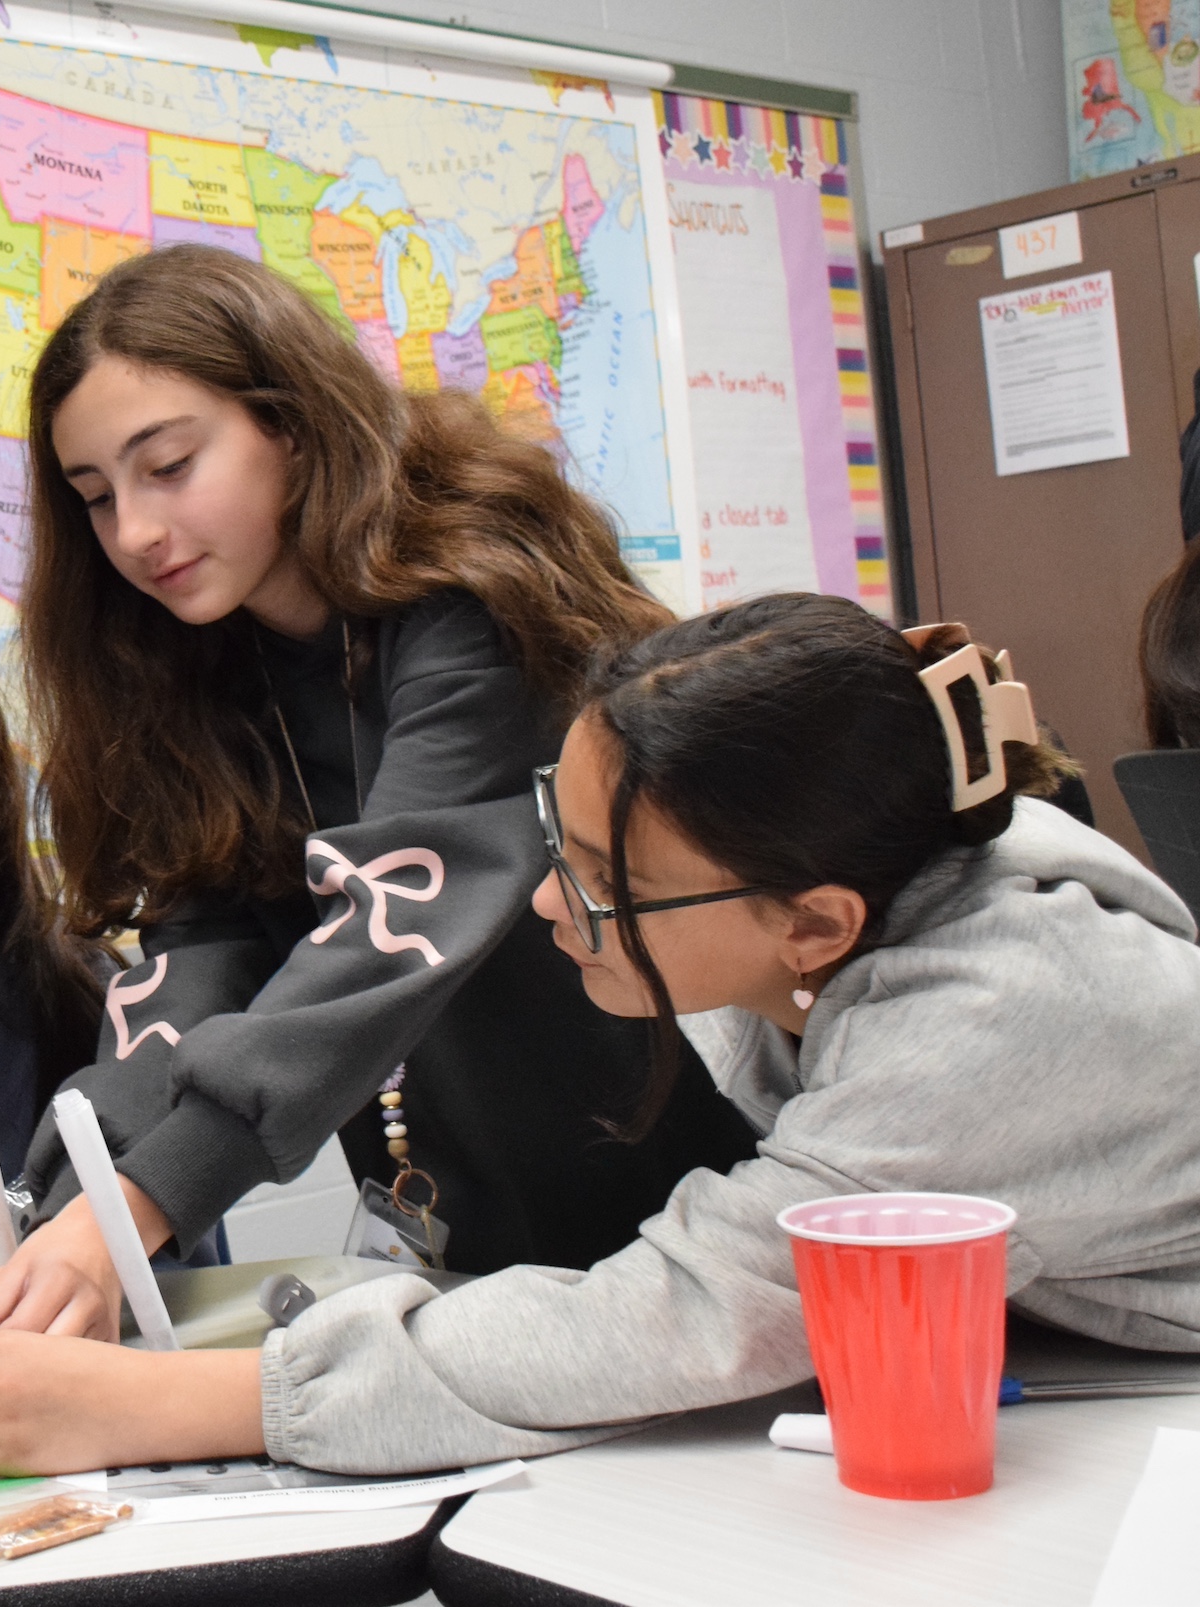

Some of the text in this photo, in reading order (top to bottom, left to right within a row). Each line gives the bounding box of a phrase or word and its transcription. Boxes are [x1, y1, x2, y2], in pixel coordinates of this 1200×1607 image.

[64, 70, 176, 110] CANADA
[33, 152, 103, 182] MONTANA
[188, 178, 227, 193] NORTH
[182, 200, 229, 216] DAKOTA
[255, 204, 313, 216] MINNESOTA
[1016, 225, 1057, 258] 437
[719, 504, 760, 527] closed
[765, 505, 789, 525] tab
